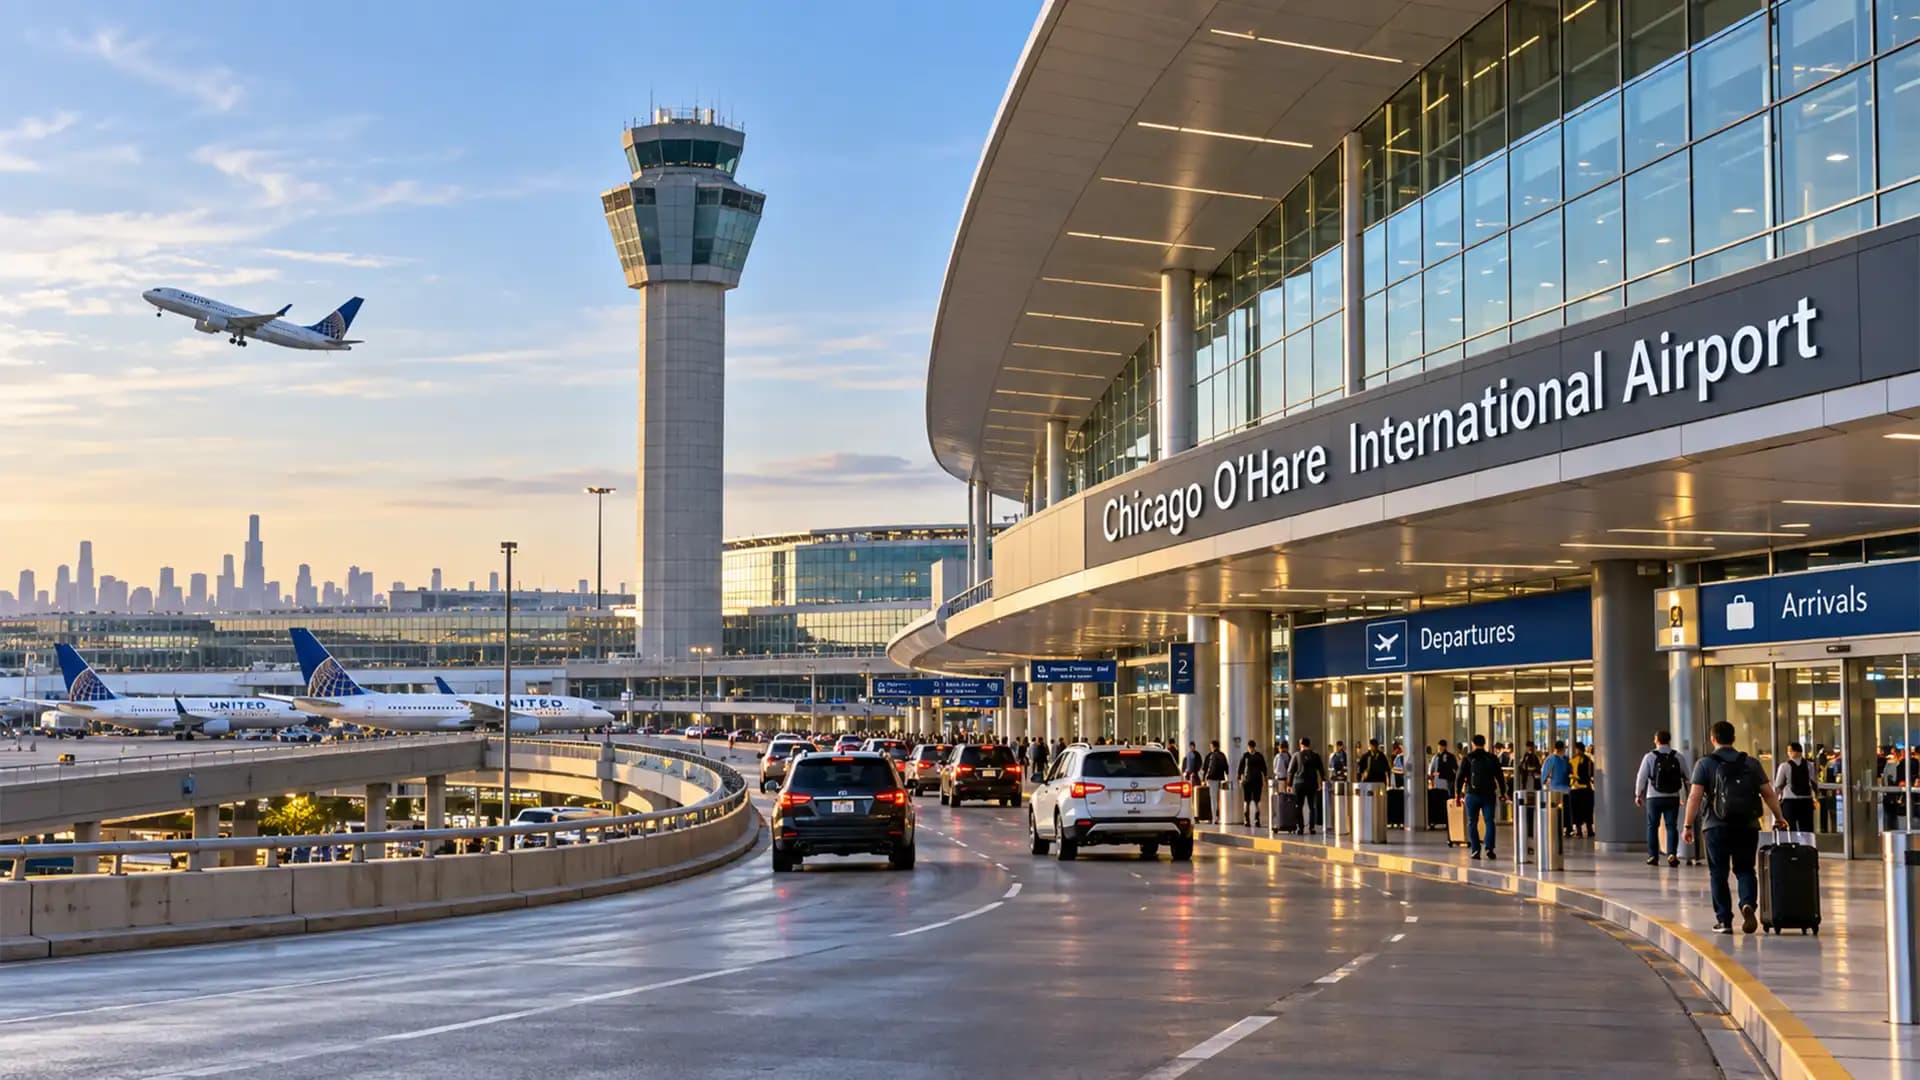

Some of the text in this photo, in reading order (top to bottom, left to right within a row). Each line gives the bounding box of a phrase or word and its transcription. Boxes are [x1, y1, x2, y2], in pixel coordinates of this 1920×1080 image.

[1102, 296, 1820, 543] Chicago O'Hare International Airport
[1781, 584, 1869, 620] Arrivals
[1420, 624, 1516, 655] Departures
[1178, 659, 1189, 674] 2
[209, 701, 267, 710] UNITED
